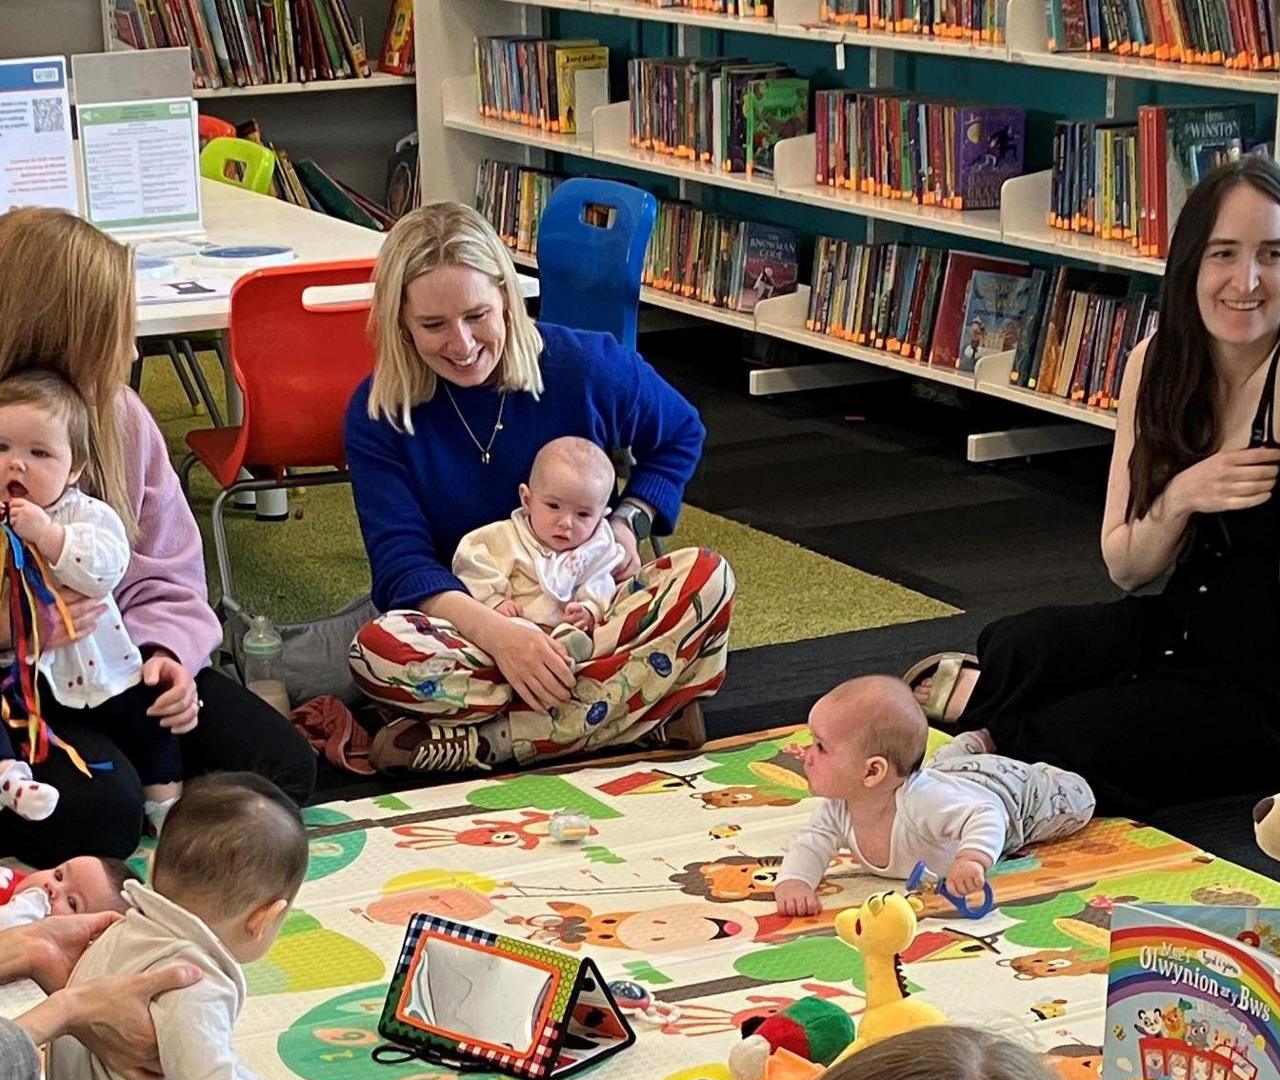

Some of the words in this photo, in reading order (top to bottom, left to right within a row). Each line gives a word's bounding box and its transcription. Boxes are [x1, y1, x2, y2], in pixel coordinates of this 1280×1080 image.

[1139, 945, 1219, 998] Olwynion
[1220, 987, 1231, 998] ar
[1231, 993, 1239, 1006] y
[1237, 985, 1271, 1022] Bws
